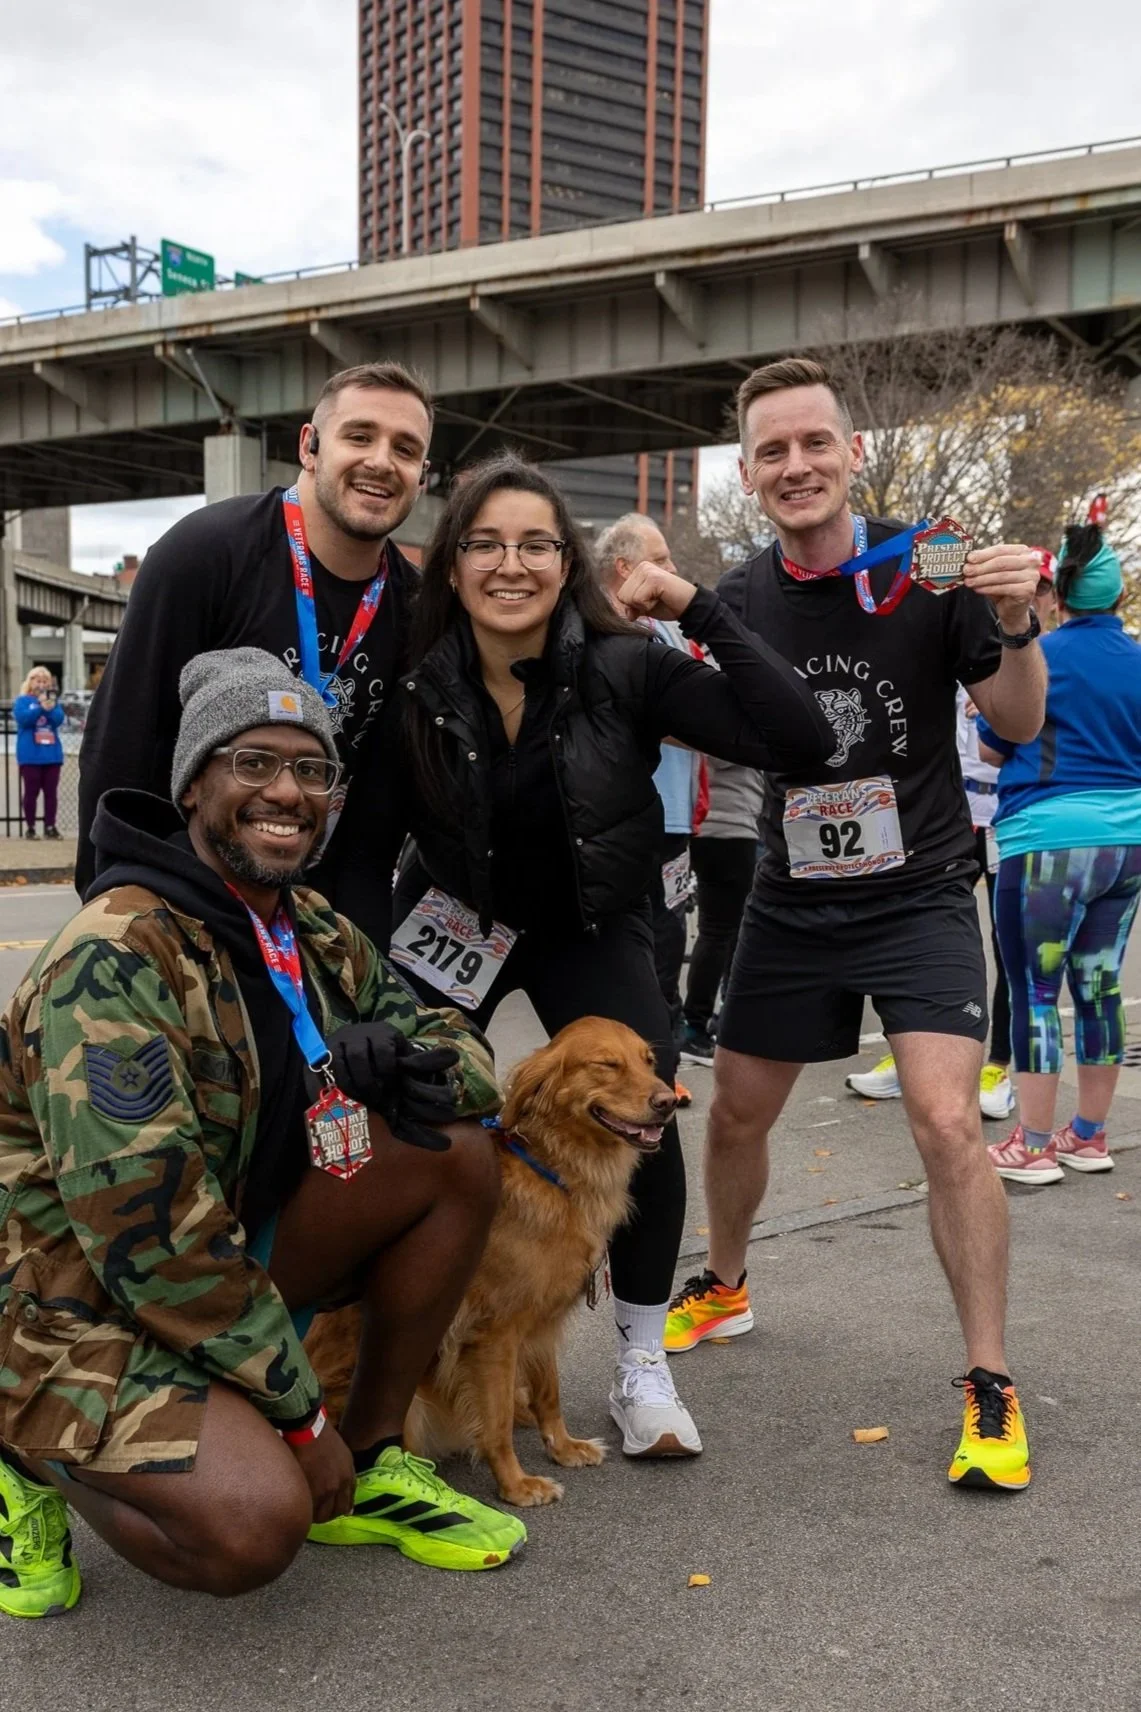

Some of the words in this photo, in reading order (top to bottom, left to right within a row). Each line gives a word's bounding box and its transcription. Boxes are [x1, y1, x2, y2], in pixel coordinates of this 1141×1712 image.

[293, 527, 307, 566] VETERANS
[916, 540, 974, 555] PRESERVE
[919, 551, 968, 565] PROTECT
[299, 567, 310, 587] RACE
[282, 632, 369, 674] RCIG
[876, 680, 908, 757] CREW
[805, 786, 868, 805] VETERANS
[820, 802, 853, 816] RACE
[819, 820, 865, 859] 92
[444, 917, 475, 940] RACE
[264, 941, 280, 964] RACE
[406, 925, 484, 985] 2179
